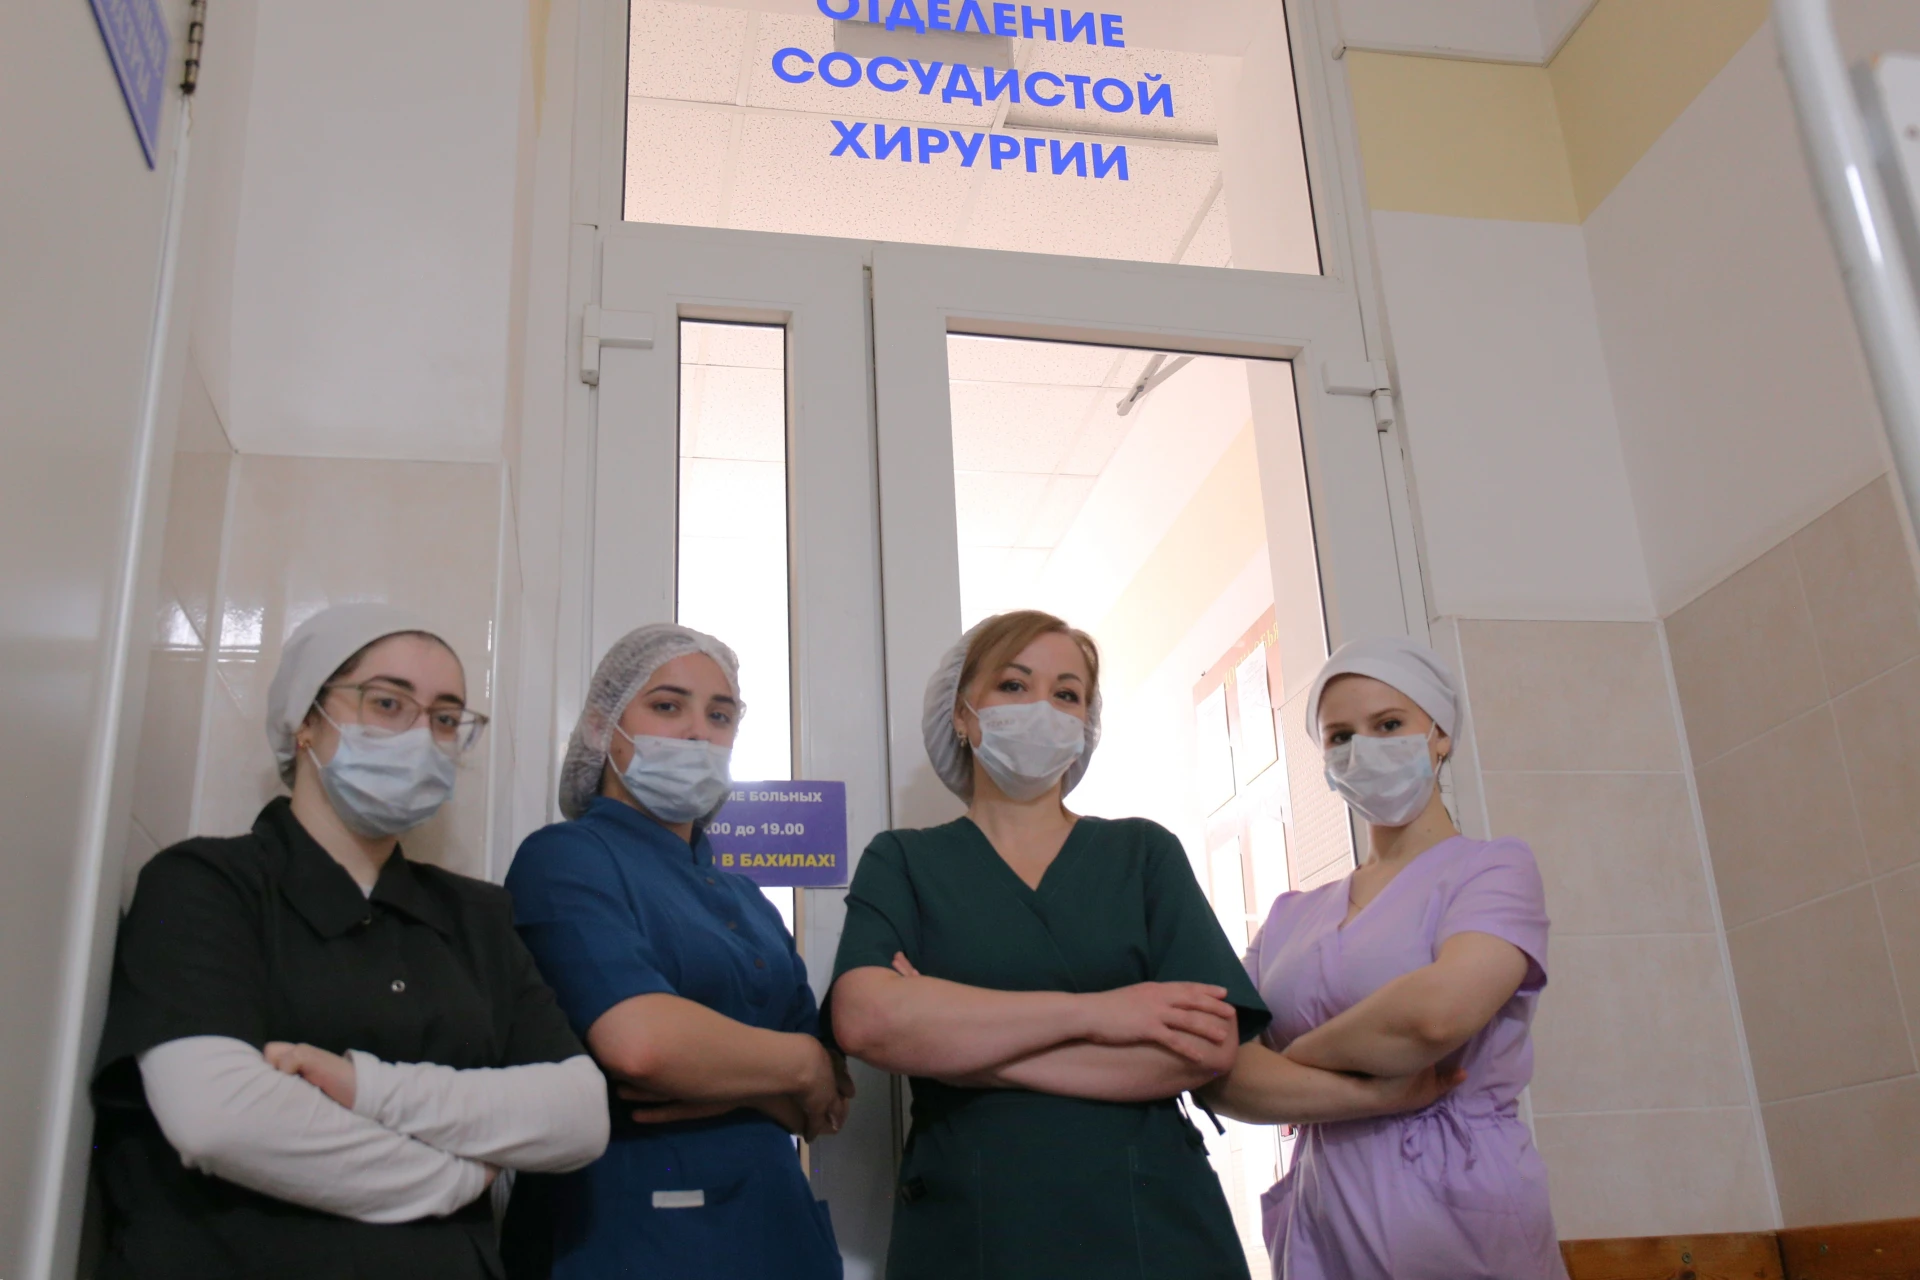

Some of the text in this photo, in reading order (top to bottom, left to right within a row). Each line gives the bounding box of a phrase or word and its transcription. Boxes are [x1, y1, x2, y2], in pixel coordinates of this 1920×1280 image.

[816, 0, 1125, 48] ОТДЕЛЕНИЕ
[771, 47, 1174, 118] СОСУДИСТОЙ
[830, 120, 1129, 181] ХИРУРГИИ
[749, 791, 822, 803] БОЛЬНЫХ
[735, 825, 755, 837] до
[761, 823, 805, 835] 19.00
[722, 853, 735, 867] В
[740, 853, 836, 867] БАХИЛАХ!
